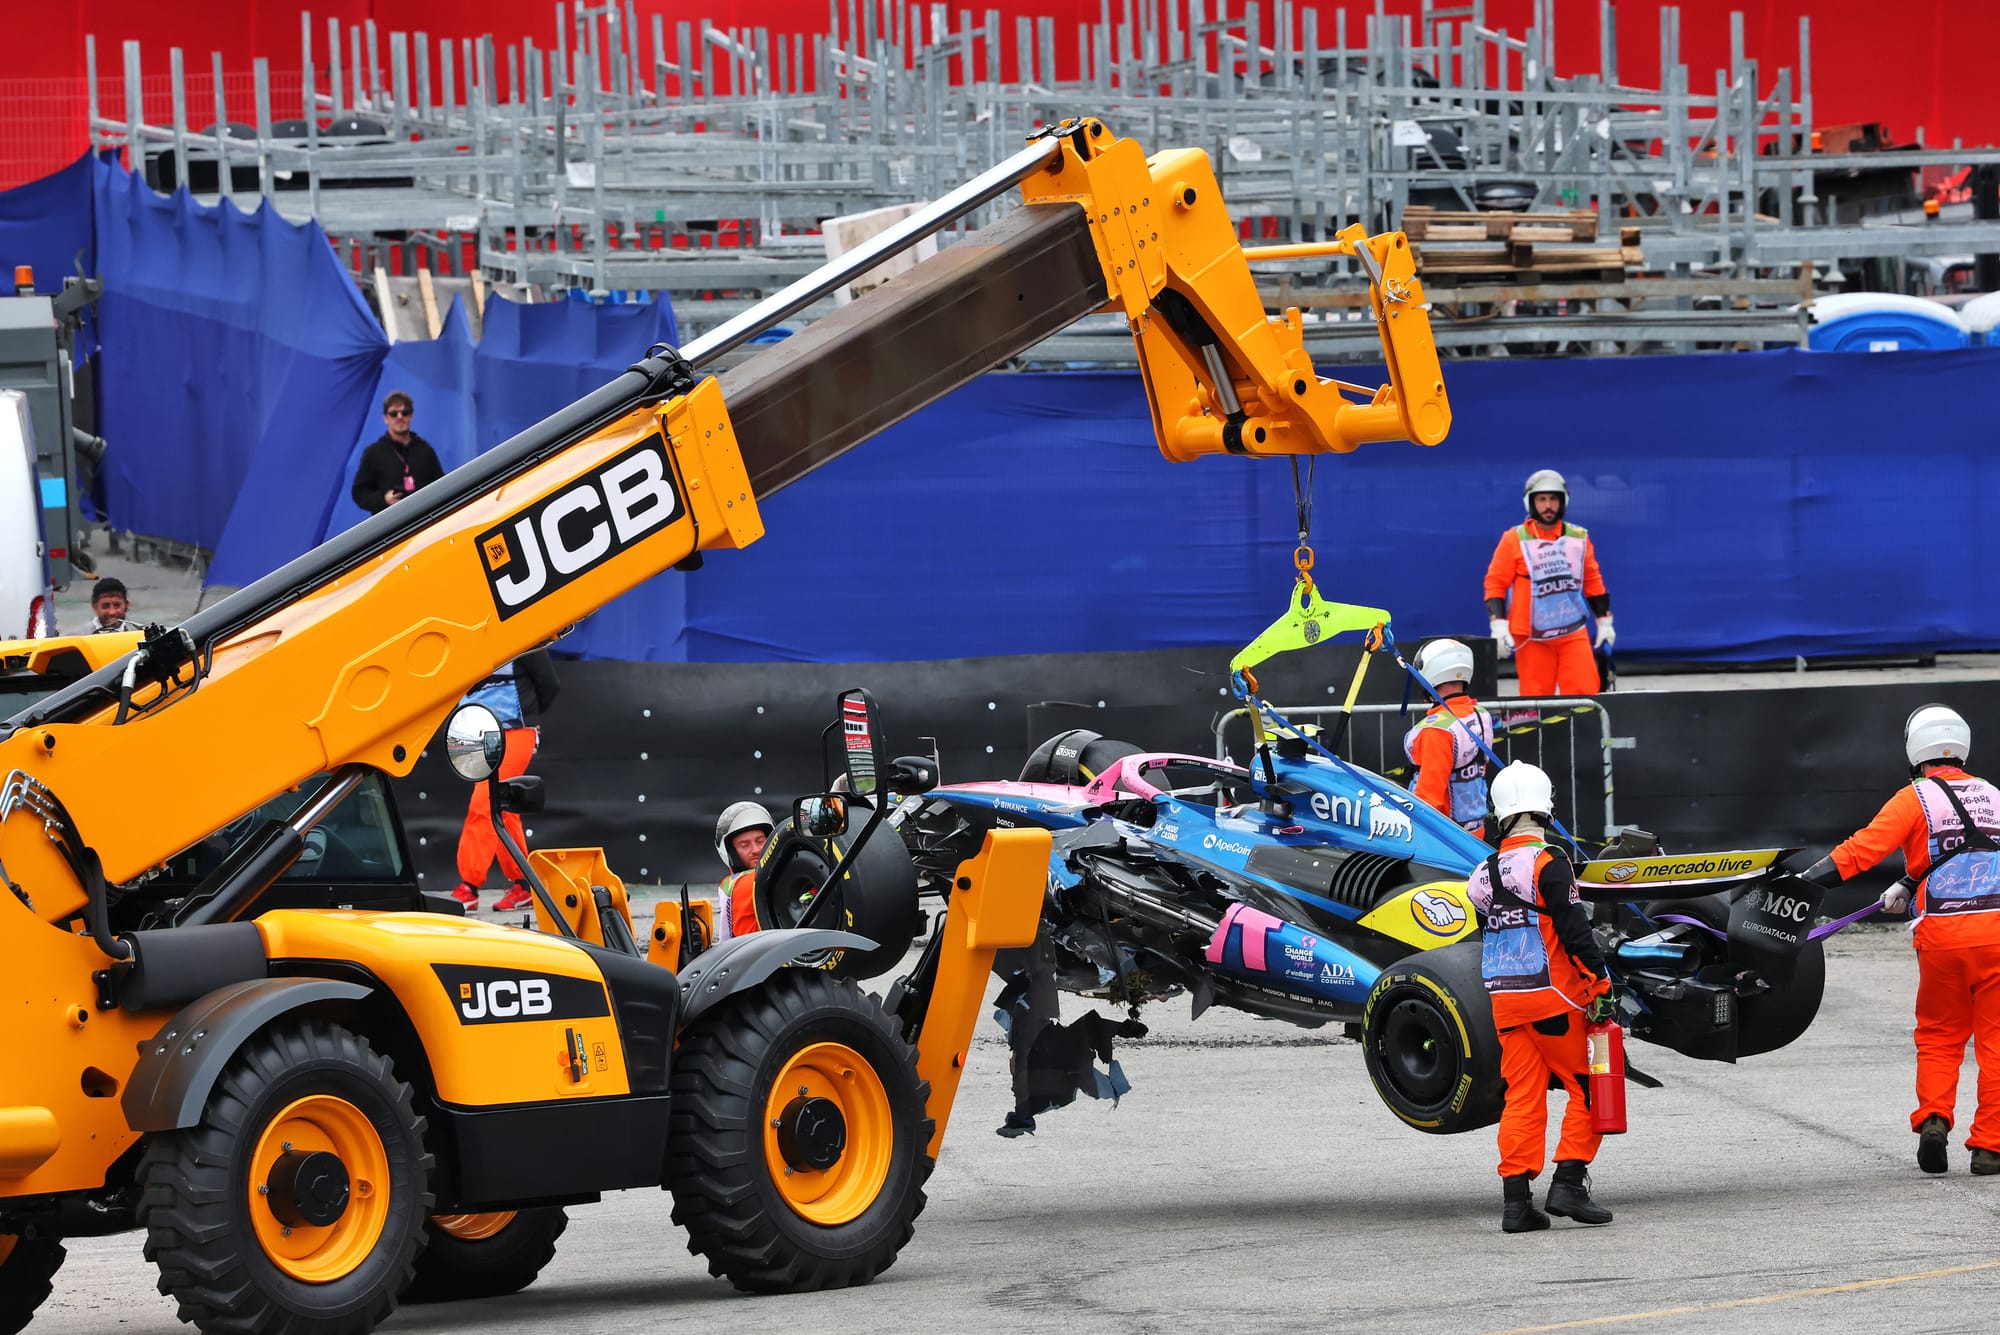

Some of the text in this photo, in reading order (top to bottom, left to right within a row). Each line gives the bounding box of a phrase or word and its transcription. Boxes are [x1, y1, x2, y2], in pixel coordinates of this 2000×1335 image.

[496, 449, 675, 606] JCB
[1000, 800, 1028, 814] BINANCE
[1310, 789, 1366, 828] eni
[996, 816, 1015, 828] banco
[1161, 831, 1178, 842] CASINO
[1214, 840, 1251, 857] ApeCoin
[1642, 857, 1752, 877] mercado livre
[1761, 891, 1810, 922] MSC
[1742, 920, 1797, 943] EURODATACAR
[1285, 947, 1313, 957] CHANGE
[1291, 953, 1313, 962] WORLD
[1320, 962, 1355, 977] ADA
[461, 978, 552, 1019] JCB
